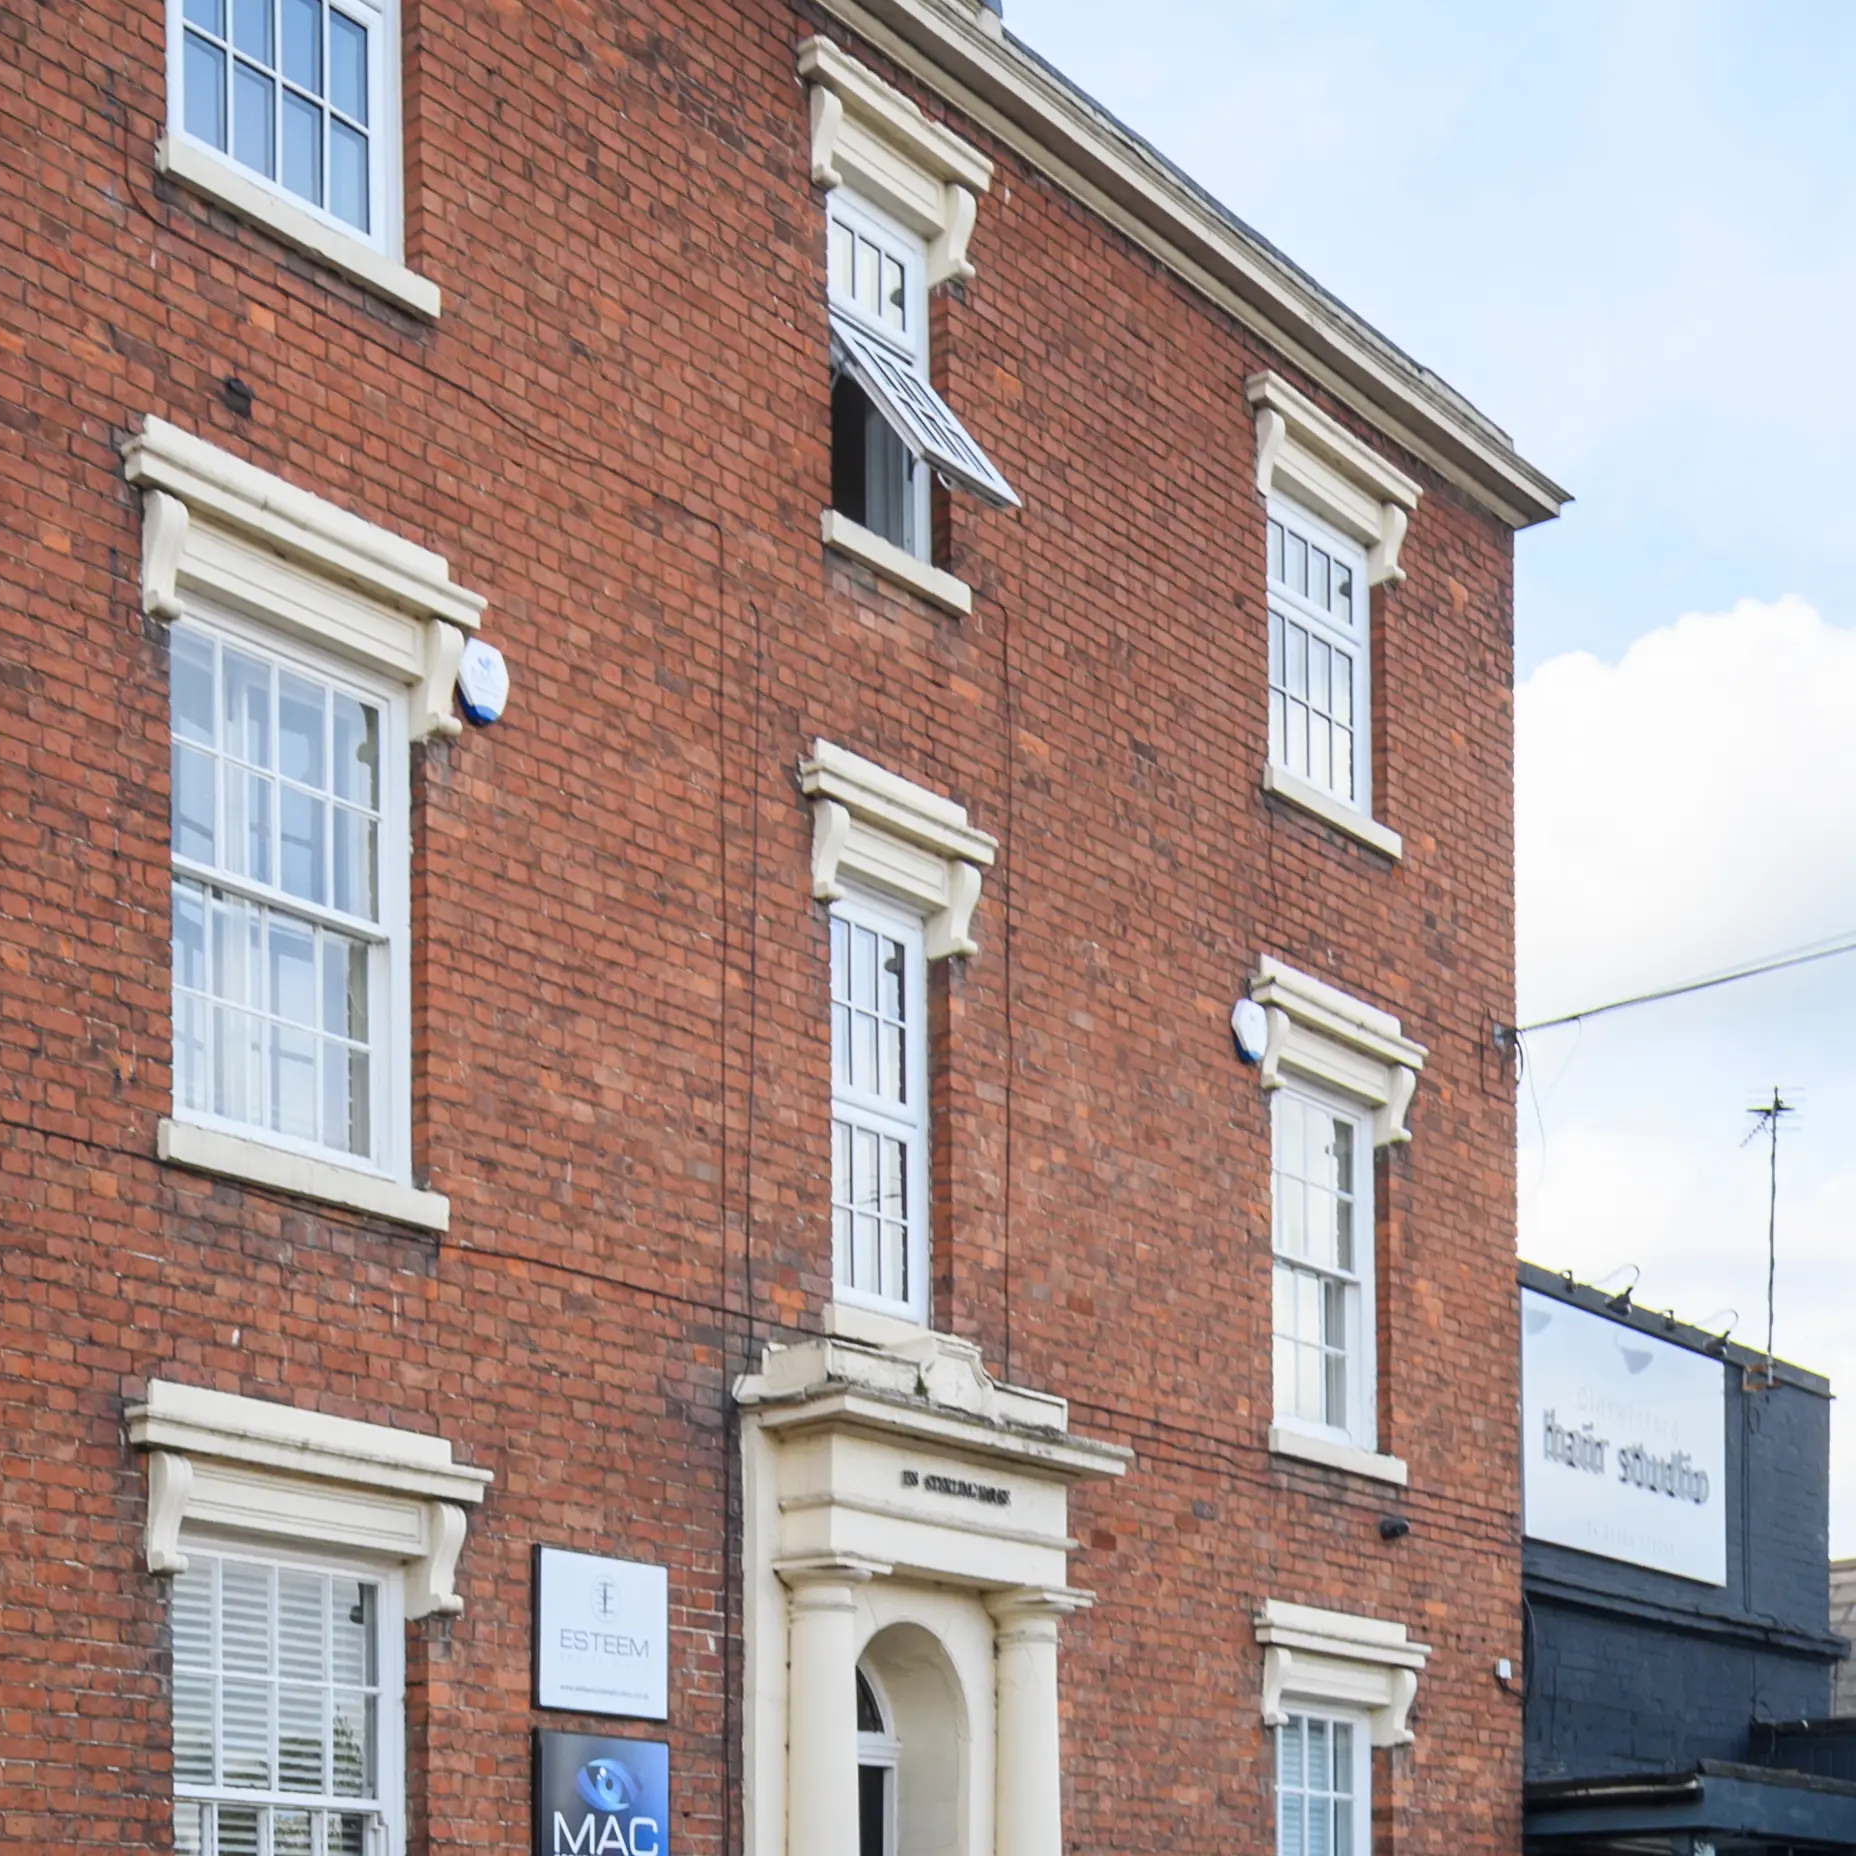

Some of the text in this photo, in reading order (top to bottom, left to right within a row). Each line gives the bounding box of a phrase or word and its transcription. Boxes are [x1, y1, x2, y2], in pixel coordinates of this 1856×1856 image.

[1543, 1408, 1710, 1505] hair studio
[560, 1628, 649, 1658] ESTEEM
